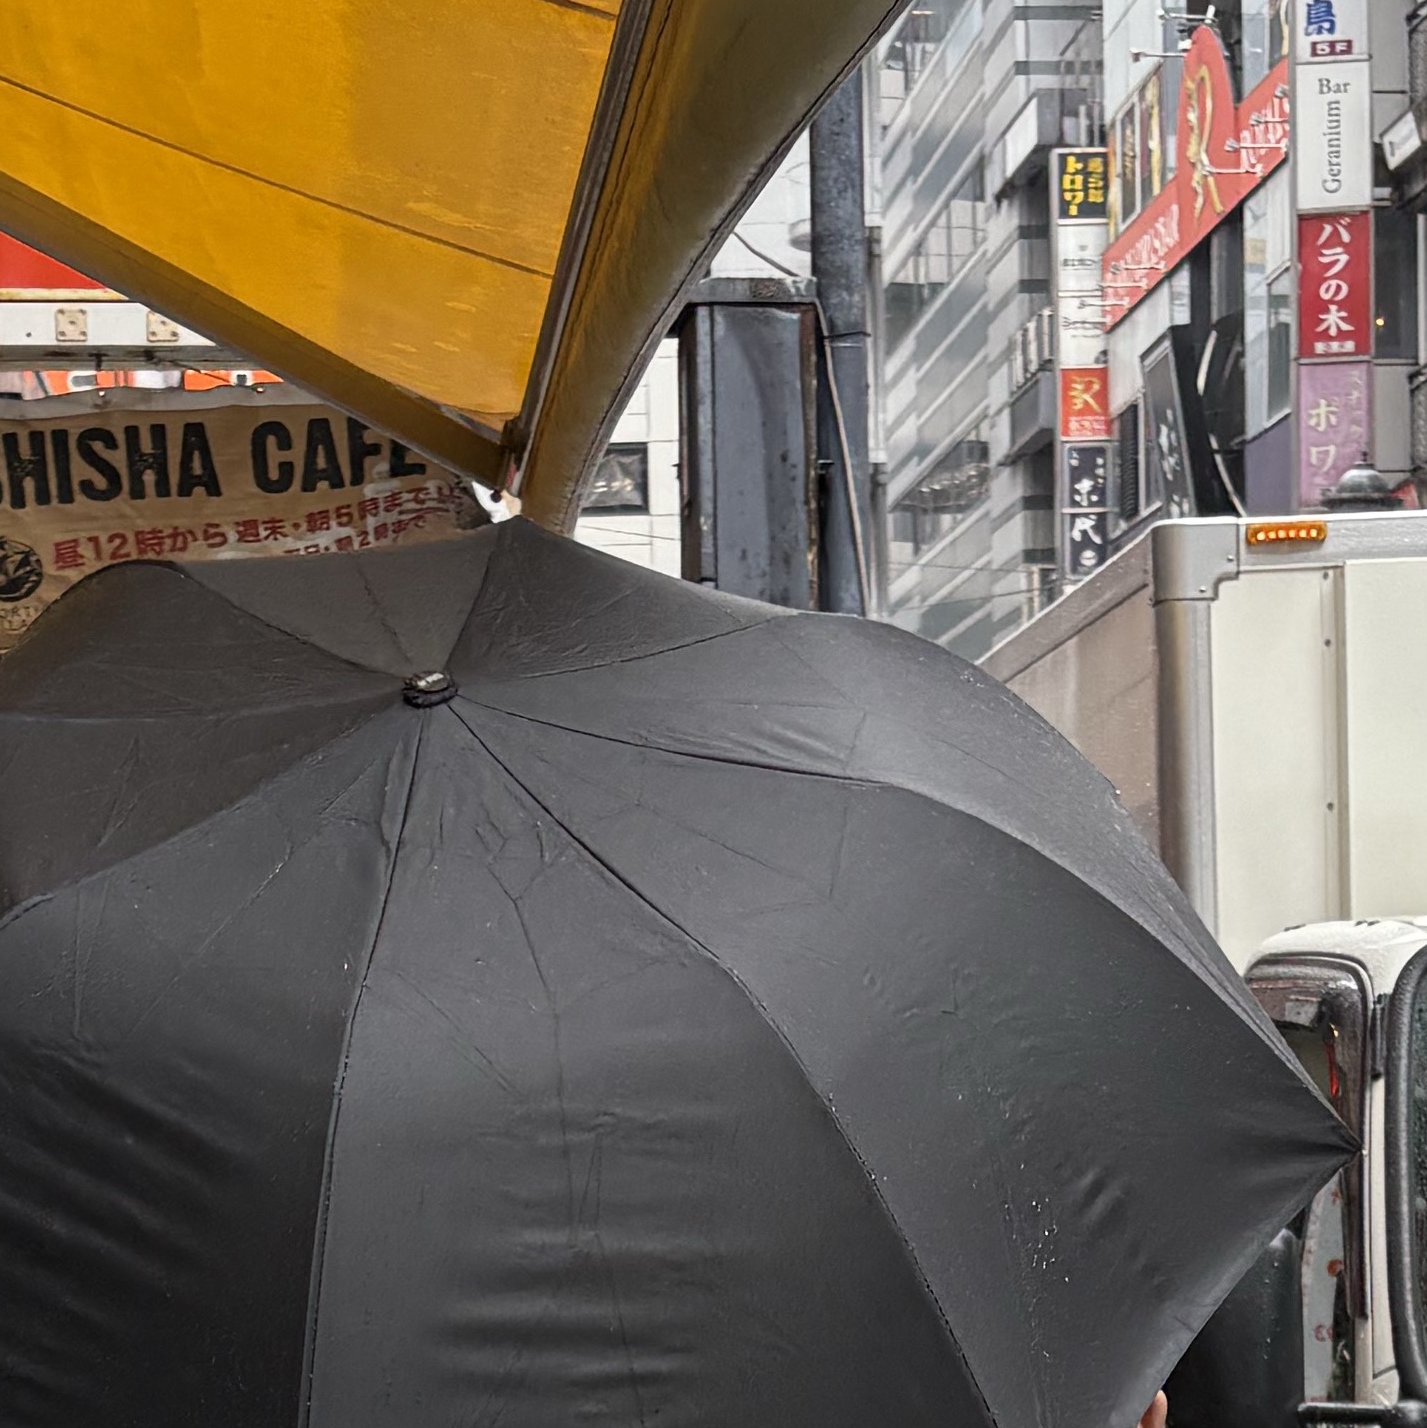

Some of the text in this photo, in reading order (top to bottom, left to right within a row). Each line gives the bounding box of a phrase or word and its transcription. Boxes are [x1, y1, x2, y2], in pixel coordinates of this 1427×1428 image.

[1318, 78, 1351, 95] Bar
[1322, 100, 1342, 194] Geranium
[1315, 216, 1356, 337] バラの木
[51, 520, 230, 572] 昼12時から
